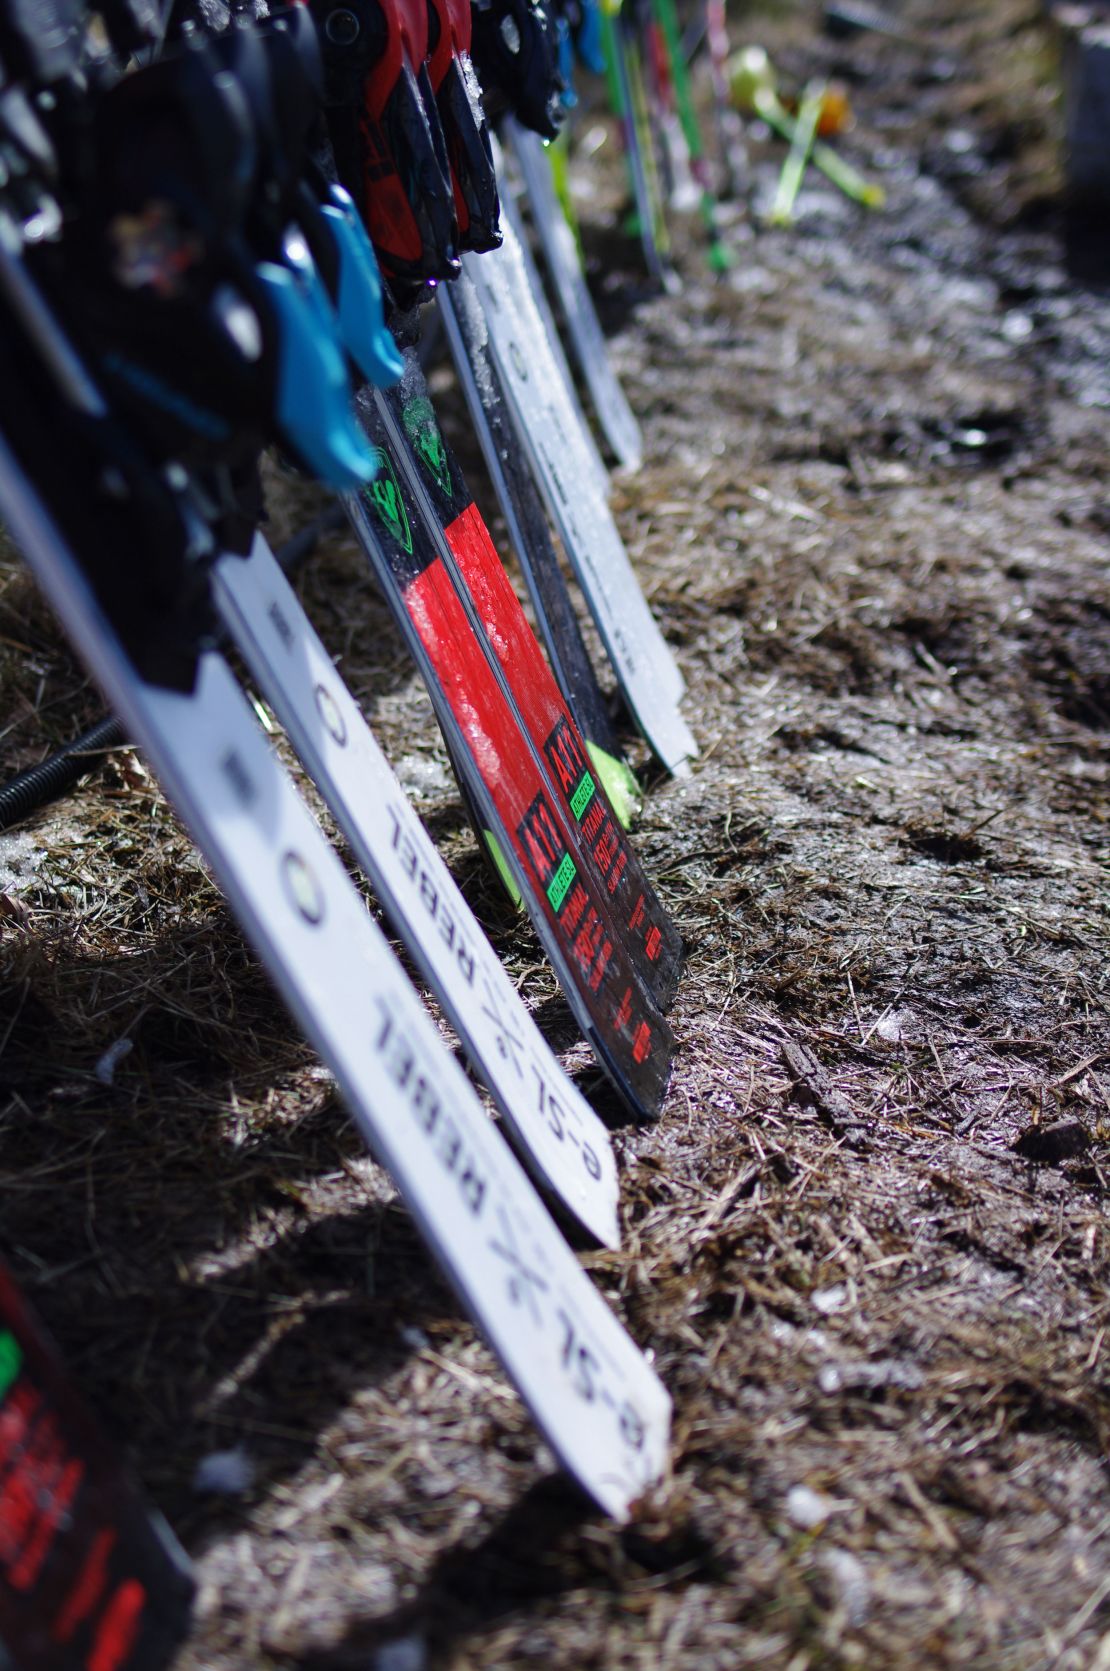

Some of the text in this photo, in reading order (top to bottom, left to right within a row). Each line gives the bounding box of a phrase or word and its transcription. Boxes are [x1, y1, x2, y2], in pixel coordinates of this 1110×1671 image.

[387, 804, 475, 988] REBEL
[581, 801, 606, 846] TITANAL
[371, 994, 487, 1219] REBEL
[531, 1064, 601, 1182] e-SL
